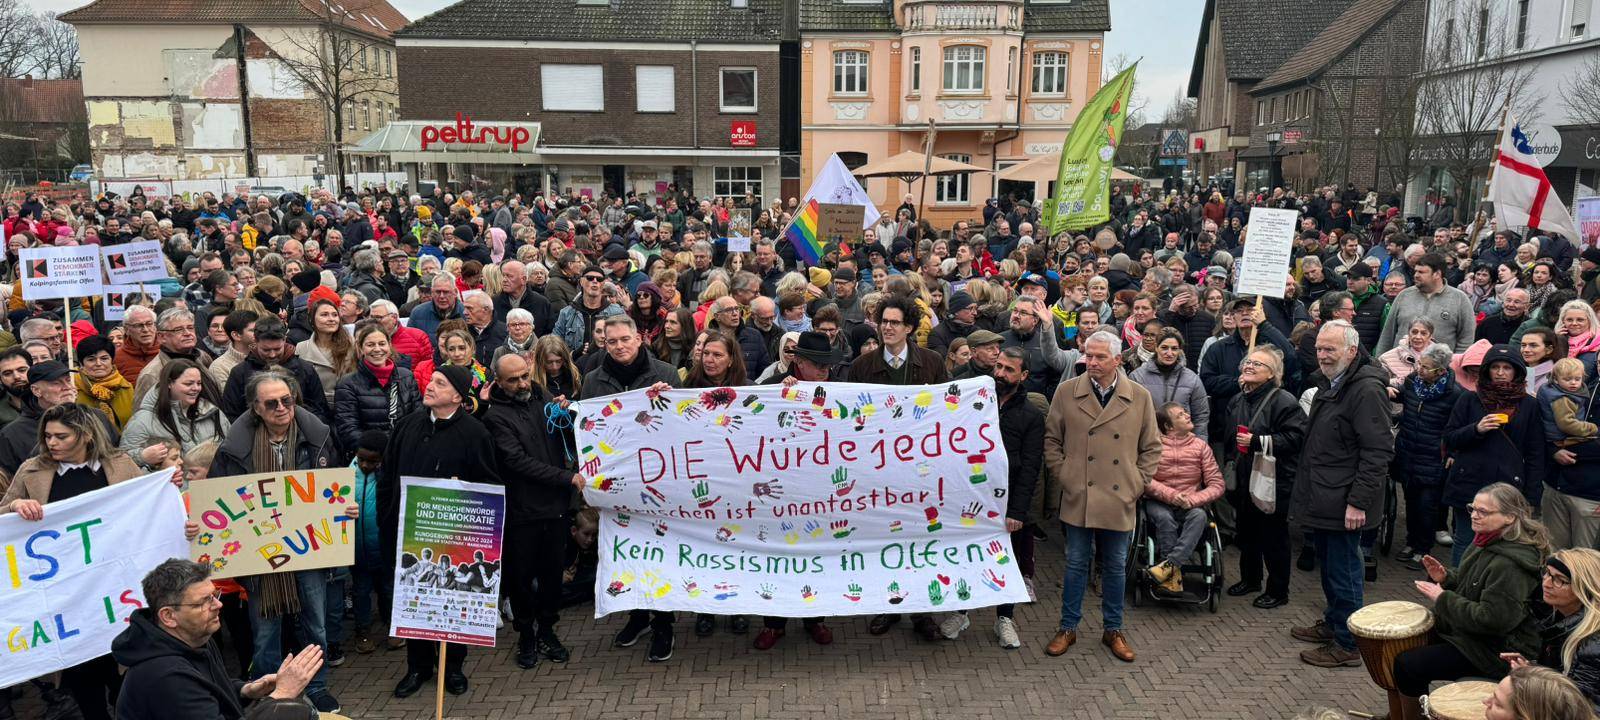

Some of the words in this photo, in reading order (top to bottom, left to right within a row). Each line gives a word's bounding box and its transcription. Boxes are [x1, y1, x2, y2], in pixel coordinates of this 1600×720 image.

[421, 112, 529, 152] pettrup
[29, 279, 78, 287] Kolpingsfamilie
[53, 262, 94, 270] DEMOKRATIE
[54, 269, 87, 277] STÄRKEN!
[638, 440, 708, 484] DIE
[725, 429, 858, 474] Würde
[870, 421, 995, 469] jedes
[201, 472, 316, 530] OLFEN
[416, 501, 431, 510] FÜR
[432, 504, 496, 517] MENSCHENWÜRDE
[416, 509, 435, 519] UND
[437, 512, 495, 525] DEMOKRATIE
[726, 501, 756, 519] ist
[773, 477, 944, 517] unantastbar!
[248, 508, 282, 536] ist
[415, 531, 454, 540] KUNDGEBUNG
[463, 535, 479, 543] MÄRZ
[5, 518, 103, 589] IST
[256, 515, 352, 570] BUNT
[613, 535, 664, 562] Kein
[679, 543, 824, 573] Rassismus
[840, 549, 864, 571] in
[0, 613, 80, 660] GAL
